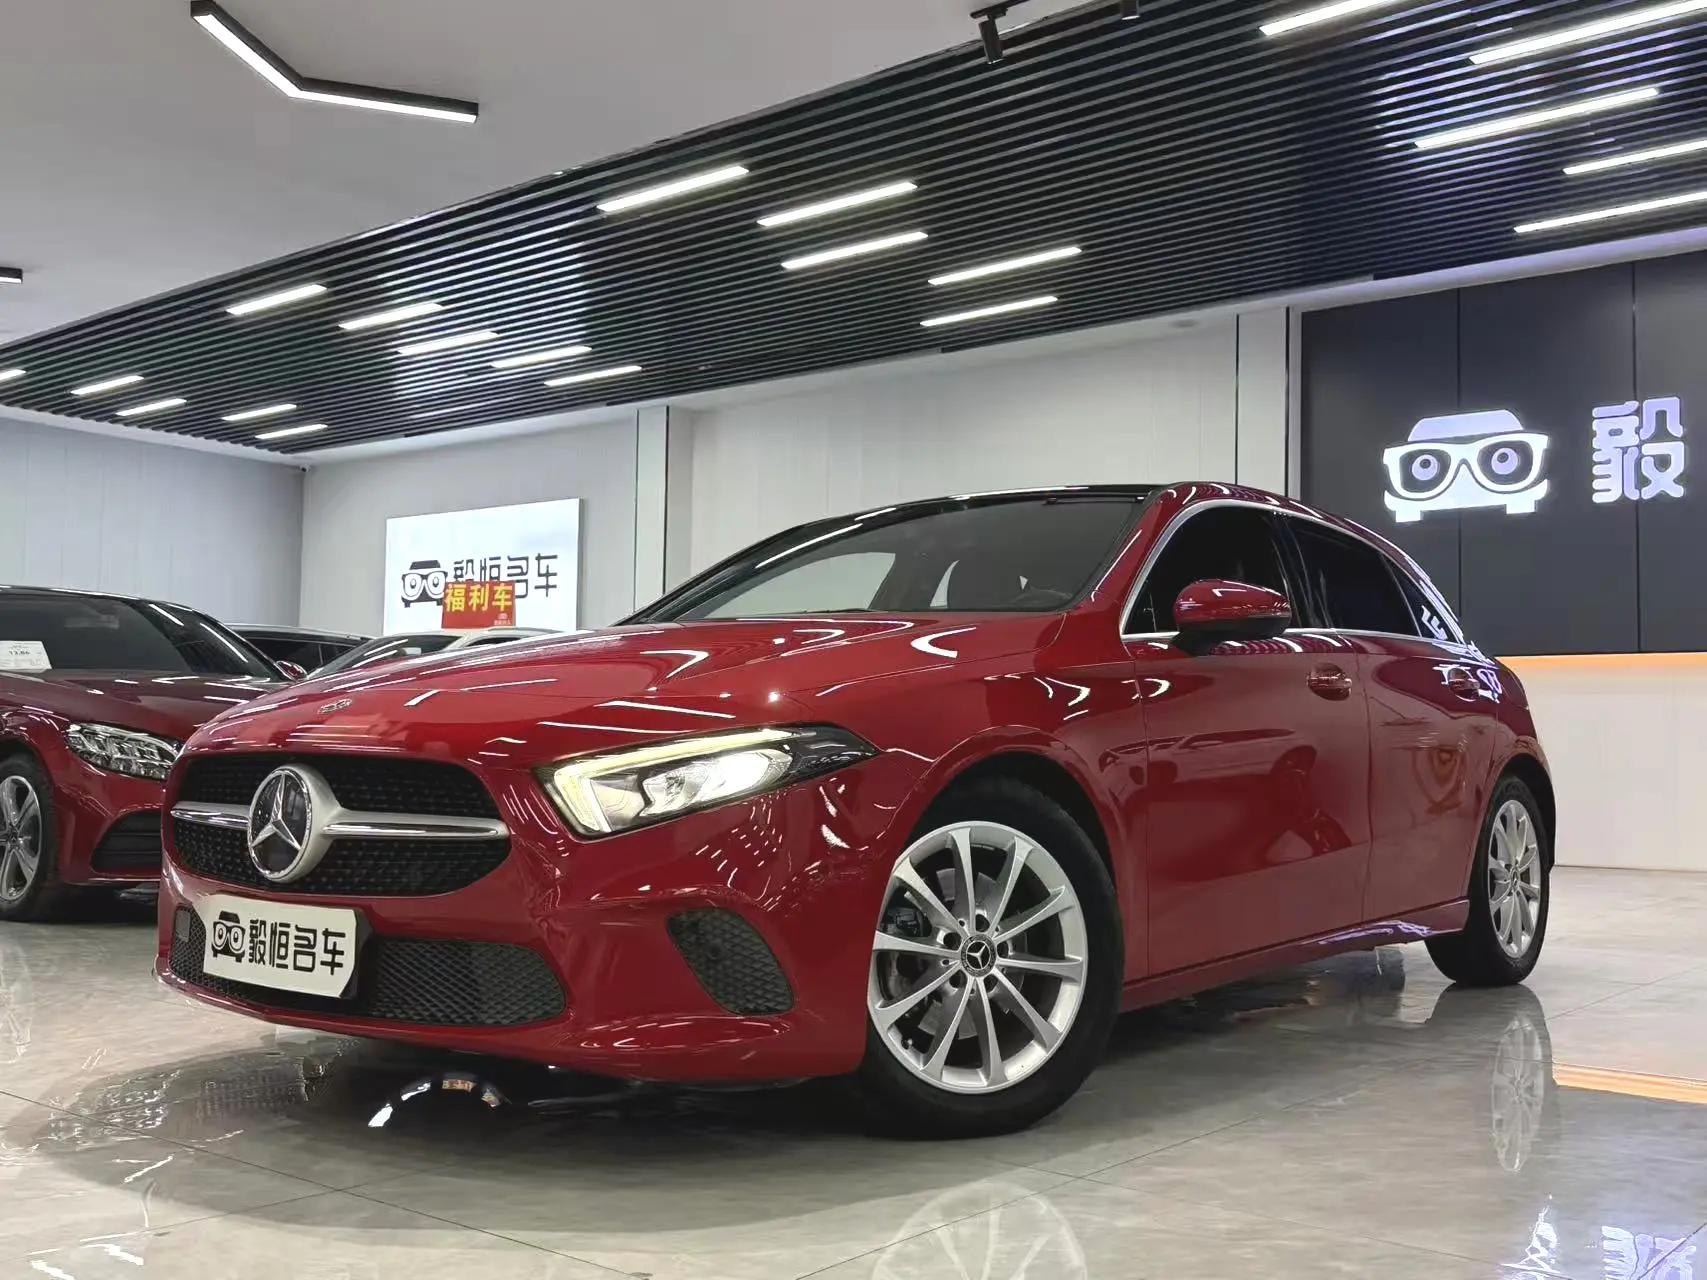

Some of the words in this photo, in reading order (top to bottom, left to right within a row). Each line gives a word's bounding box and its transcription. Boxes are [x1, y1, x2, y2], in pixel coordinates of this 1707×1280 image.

[1592, 396, 1684, 503] 毅
[444, 582, 513, 612] 福利车
[249, 918, 346, 976] 毅恒名车
